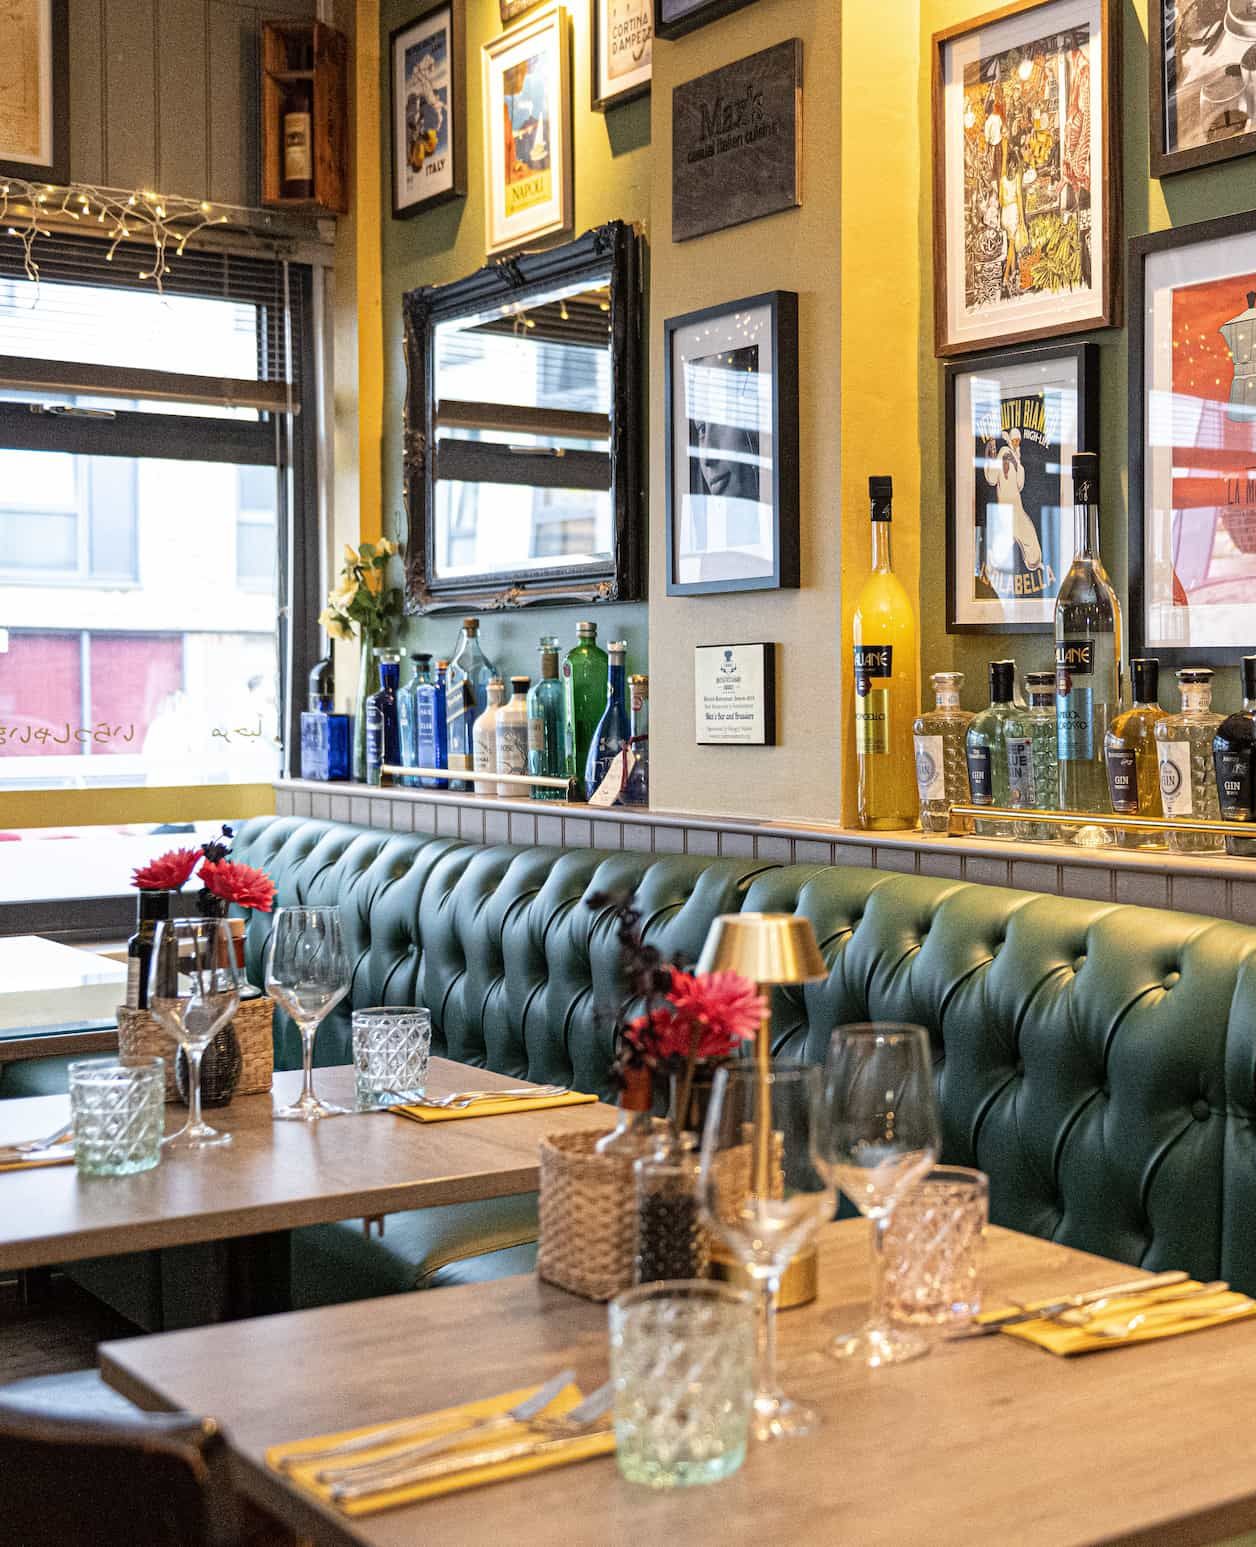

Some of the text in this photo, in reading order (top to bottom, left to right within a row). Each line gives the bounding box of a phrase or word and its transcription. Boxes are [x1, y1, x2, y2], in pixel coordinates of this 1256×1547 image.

[613, 13, 648, 40] CORTINA
[425, 158, 447, 177] ITALY
[511, 178, 544, 201] NAPOLI
[1114, 775, 1129, 785] GIN
[1224, 781, 1241, 791] GIN
